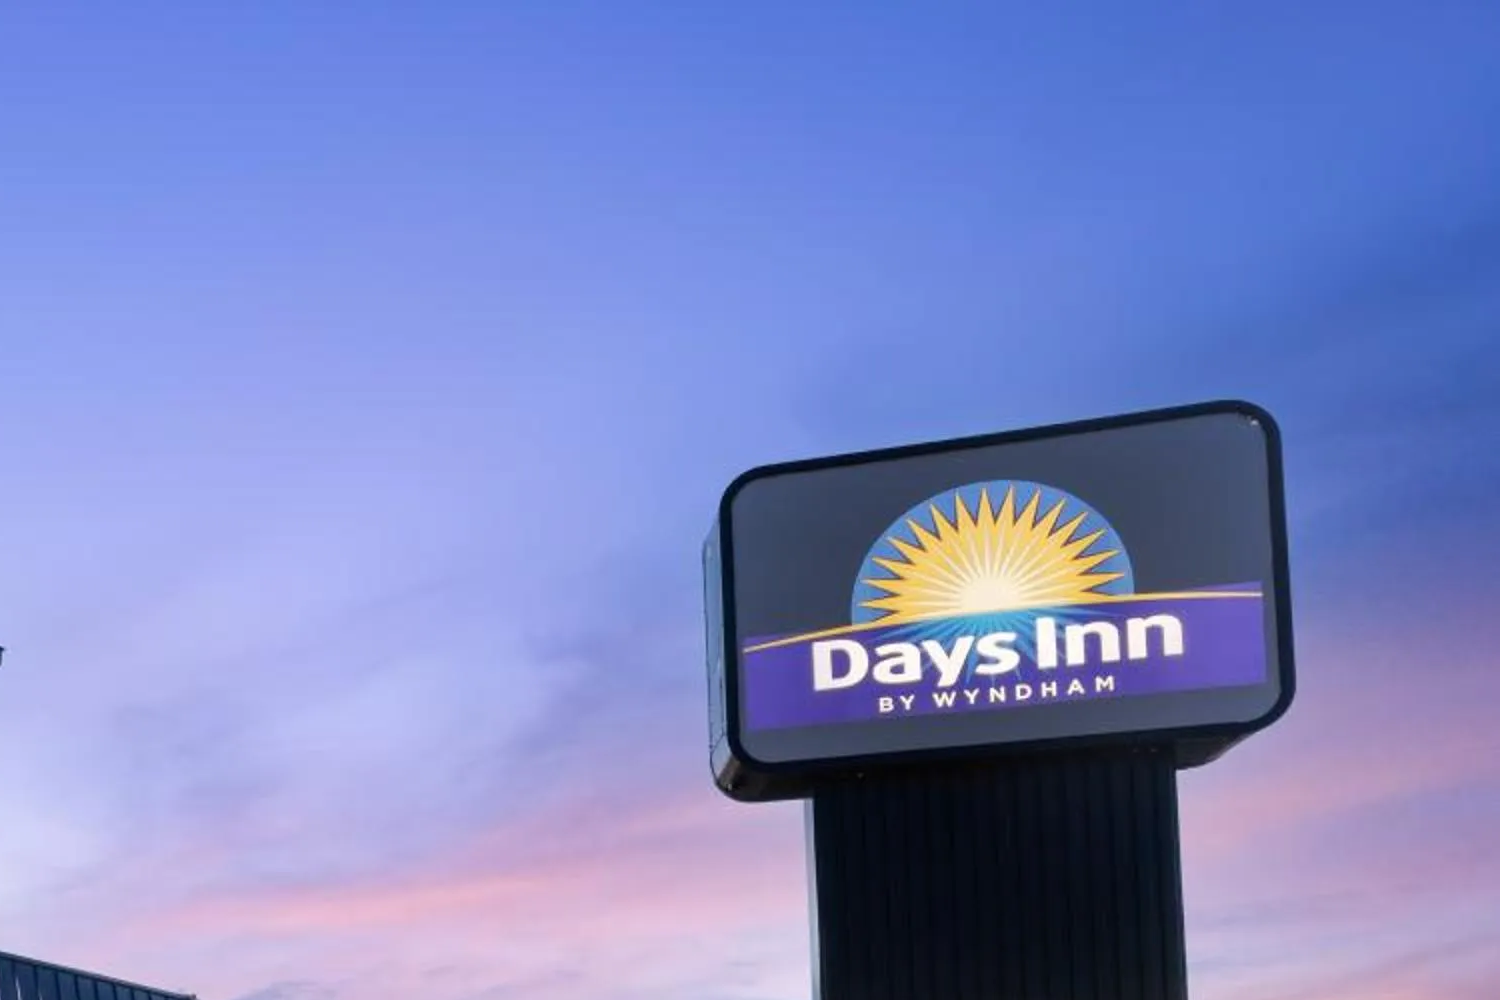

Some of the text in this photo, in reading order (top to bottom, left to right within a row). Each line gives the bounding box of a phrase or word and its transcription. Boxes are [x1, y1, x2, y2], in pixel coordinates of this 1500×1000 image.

[811, 613, 1184, 692] Days Inn
[878, 675, 1116, 714] BY WYNDHAM
